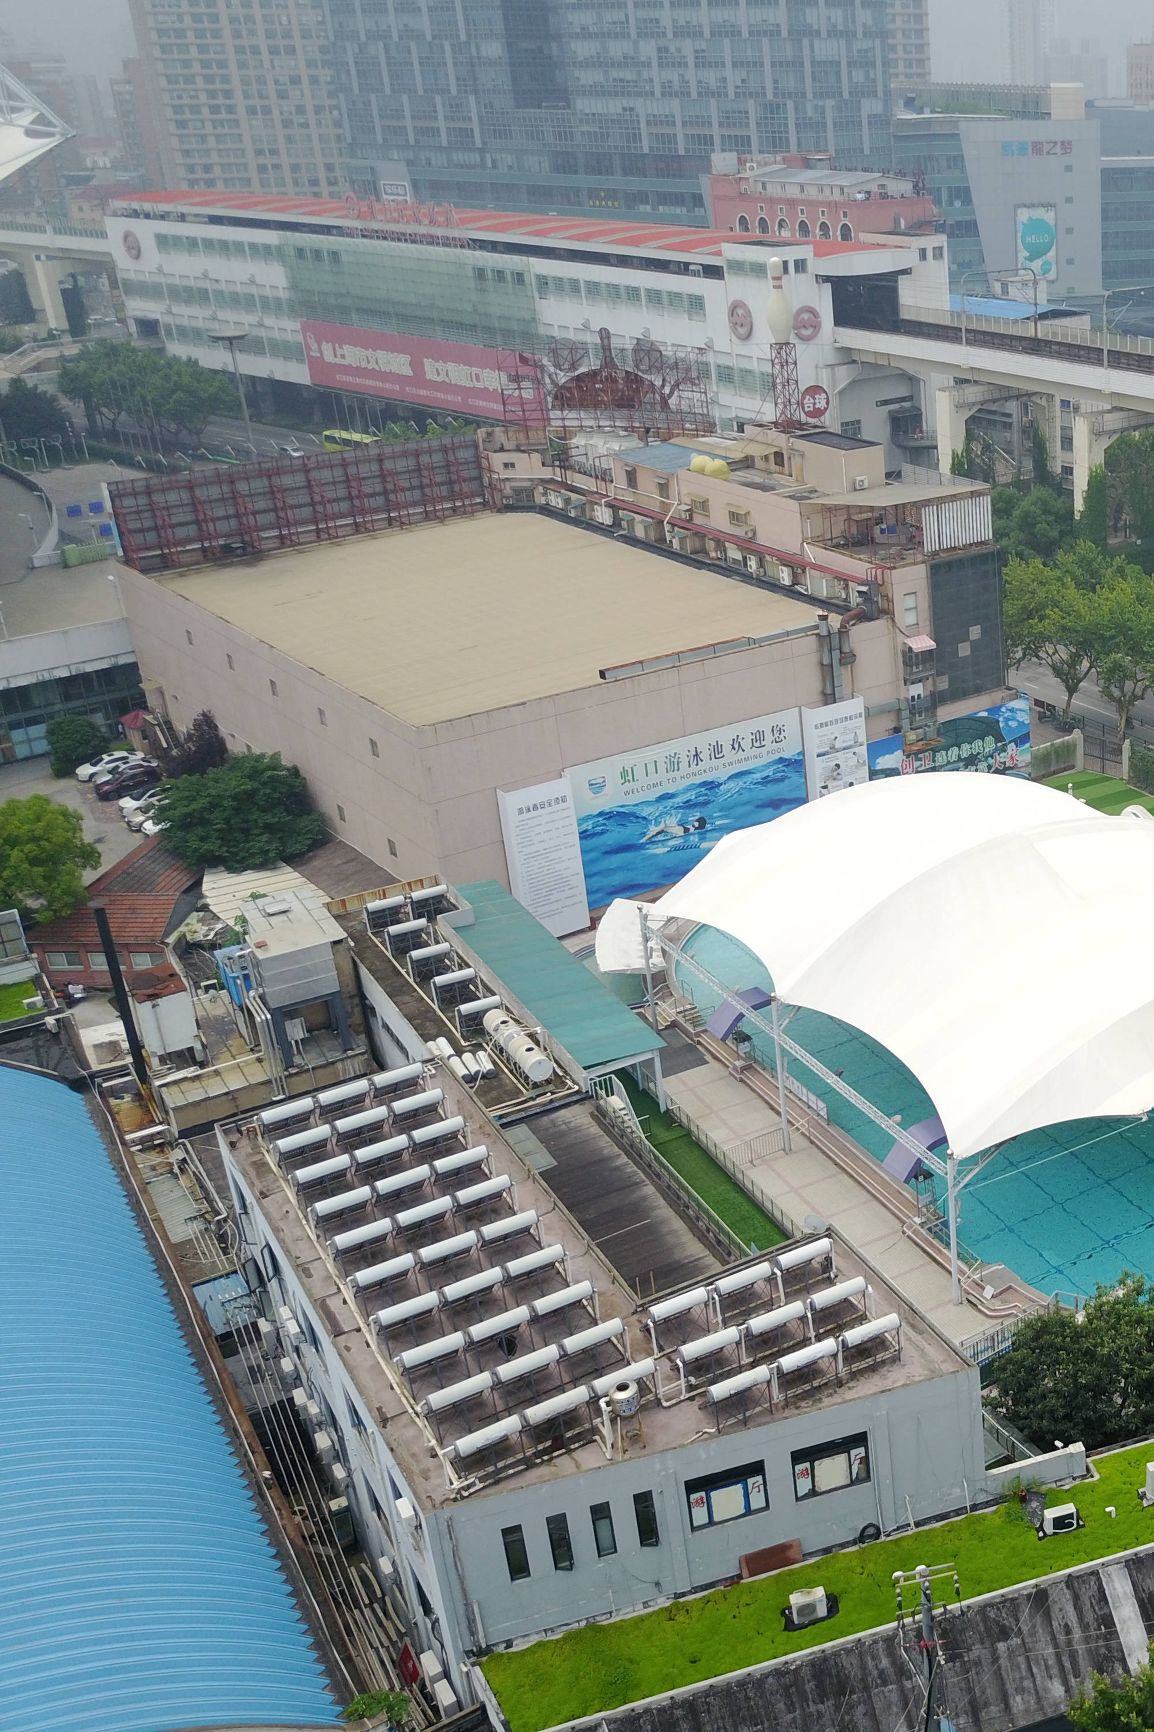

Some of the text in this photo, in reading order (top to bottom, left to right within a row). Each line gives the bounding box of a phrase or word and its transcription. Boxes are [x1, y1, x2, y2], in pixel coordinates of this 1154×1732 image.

[1025, 233, 1049, 244] HELLO
[803, 392, 828, 411] 台球
[619, 723, 788, 786] 虹口游泳池欢迎您
[623, 747, 786, 797] WELCOME TO HONGKOU SWIMMING POOL
